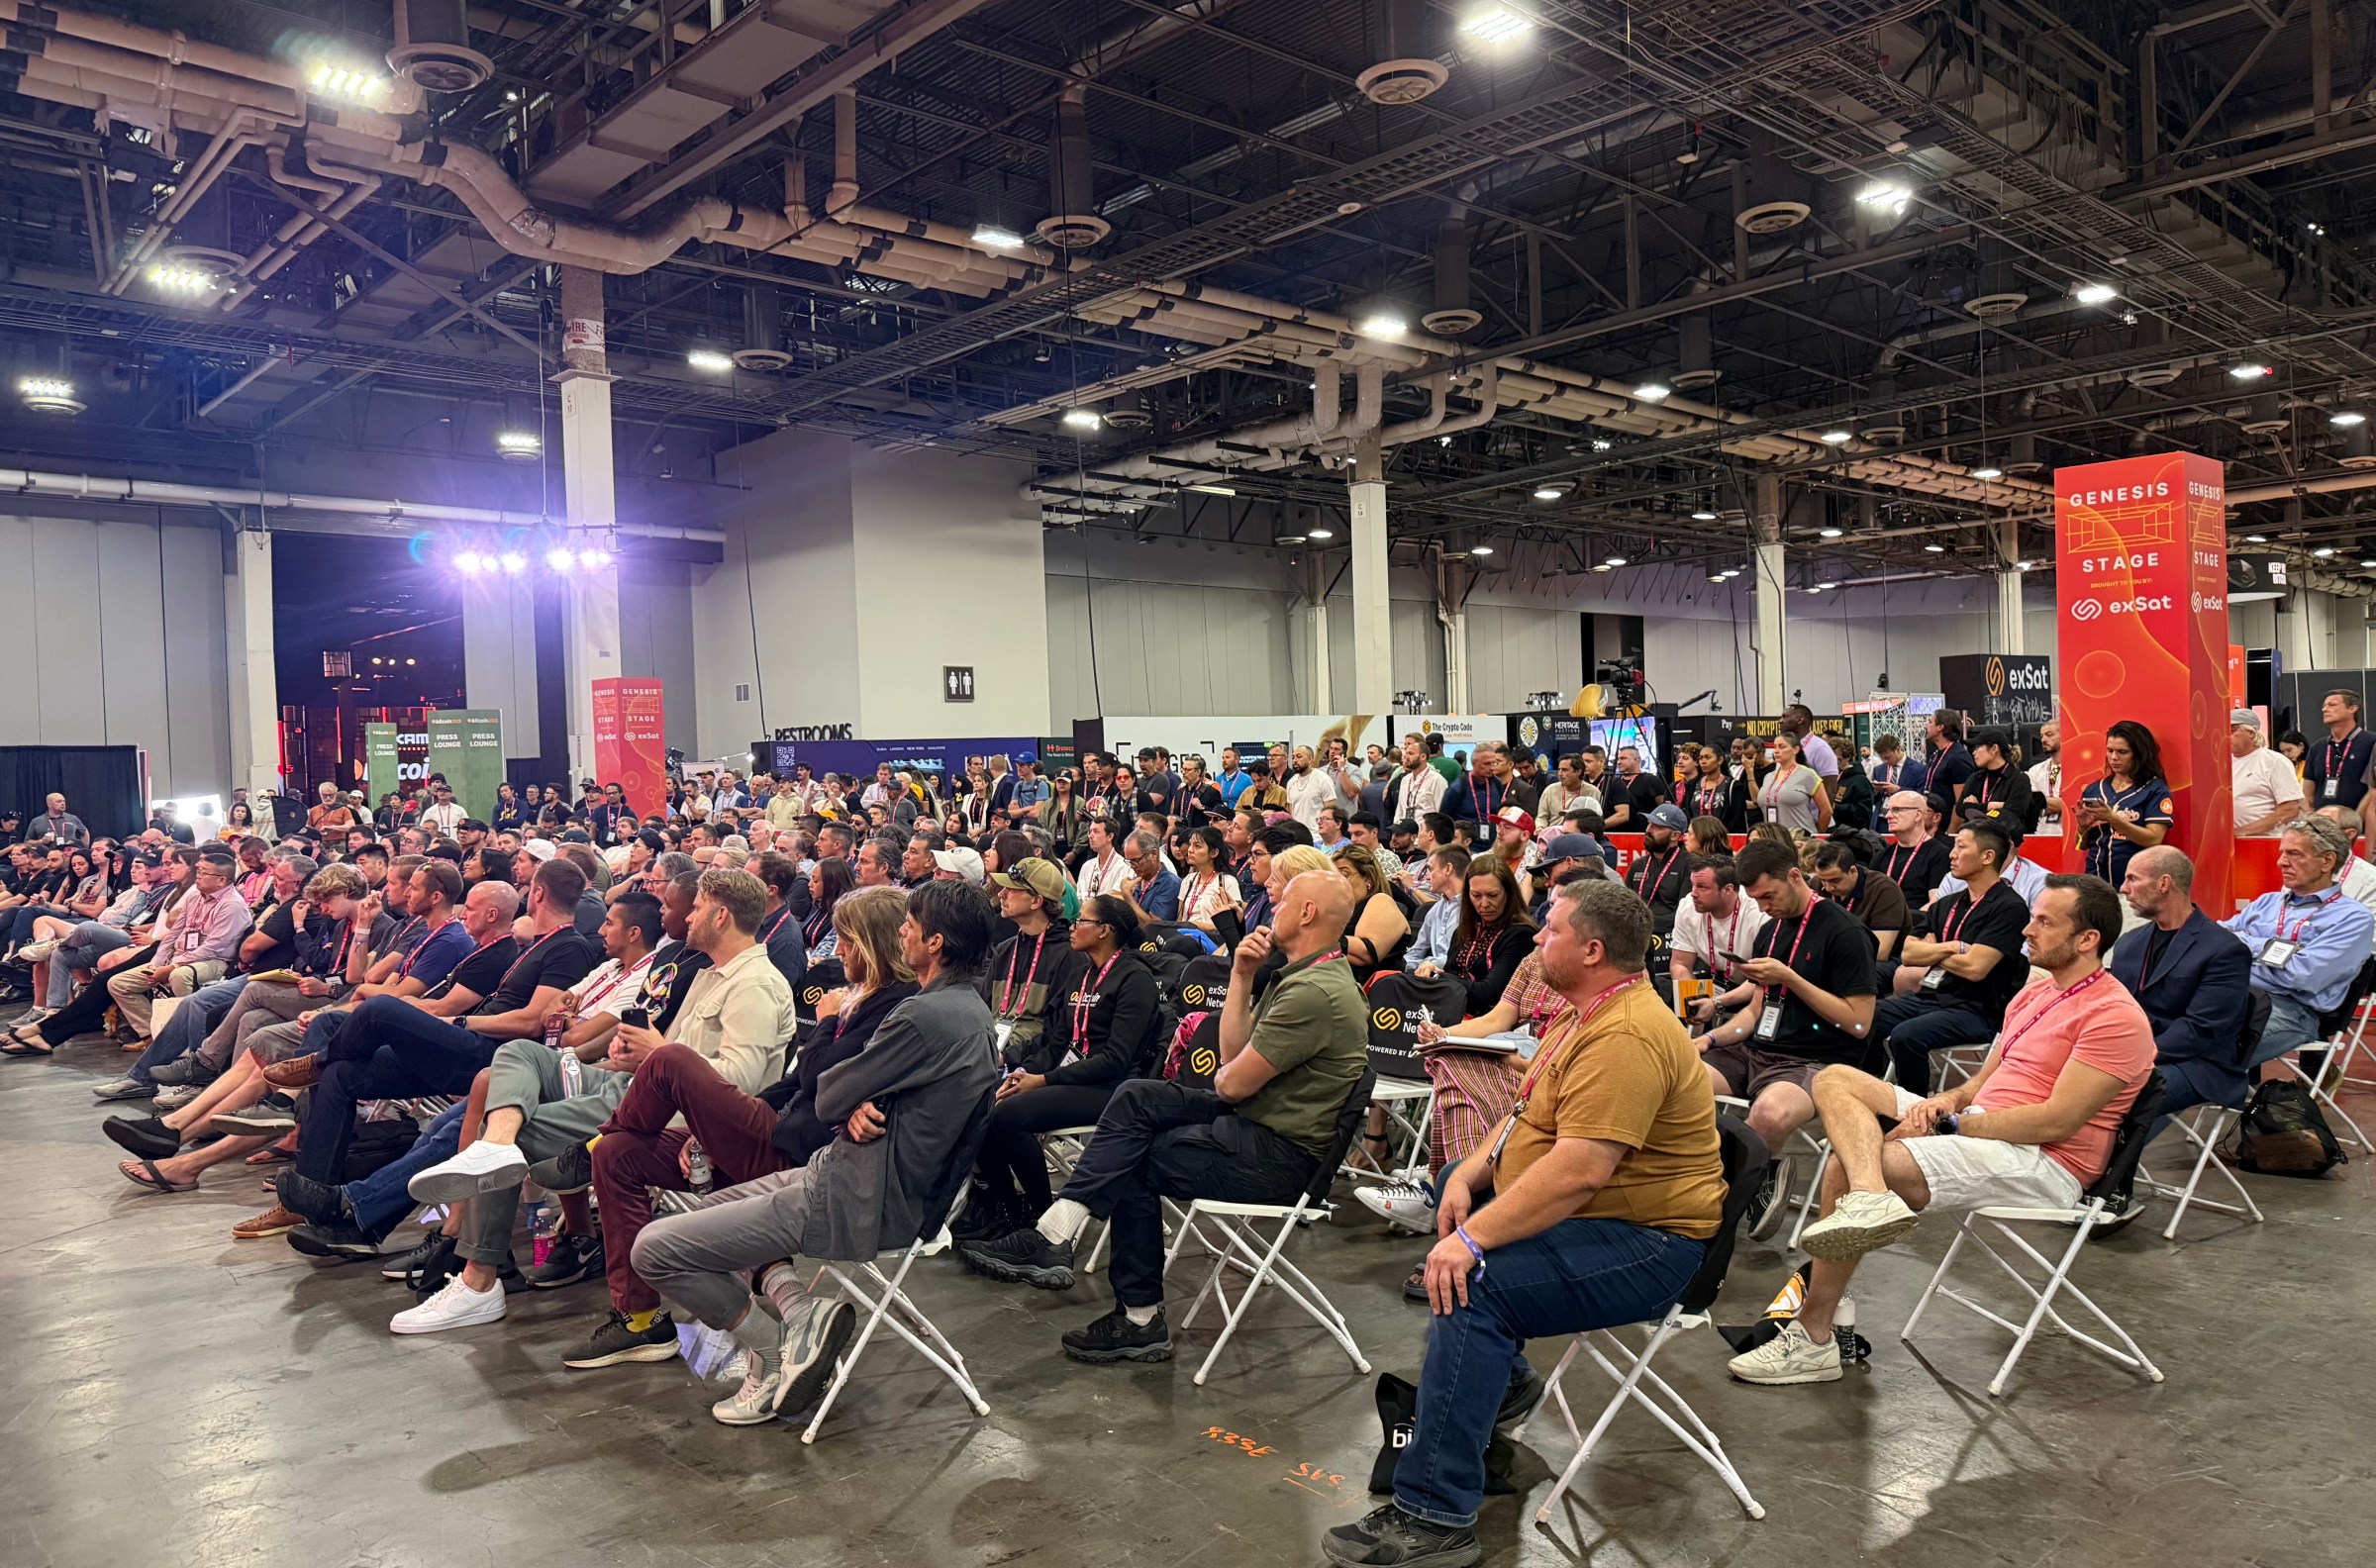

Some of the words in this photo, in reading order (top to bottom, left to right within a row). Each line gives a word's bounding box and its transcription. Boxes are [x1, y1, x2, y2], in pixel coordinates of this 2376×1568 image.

[2069, 482, 2169, 507] GENESIS
[2189, 481, 2221, 501] GENESIS
[2082, 552, 2159, 573] STAGE
[2194, 550, 2219, 567] STAGE
[2090, 580, 2120, 589] BROUGHT
[2109, 595, 2172, 614] exSat
[2203, 595, 2224, 611] exSat
[2009, 662, 2048, 690] exSat
[774, 723, 853, 741] RESTROOMS
[1433, 723, 1441, 732] The
[1441, 723, 1460, 734] Crypto
[1460, 723, 1473, 732] Code
[1722, 719, 1732, 731] Pay
[1746, 721, 1756, 735] NO
[1756, 721, 1782, 736] CRYPT
[1829, 719, 1843, 735] EVER
